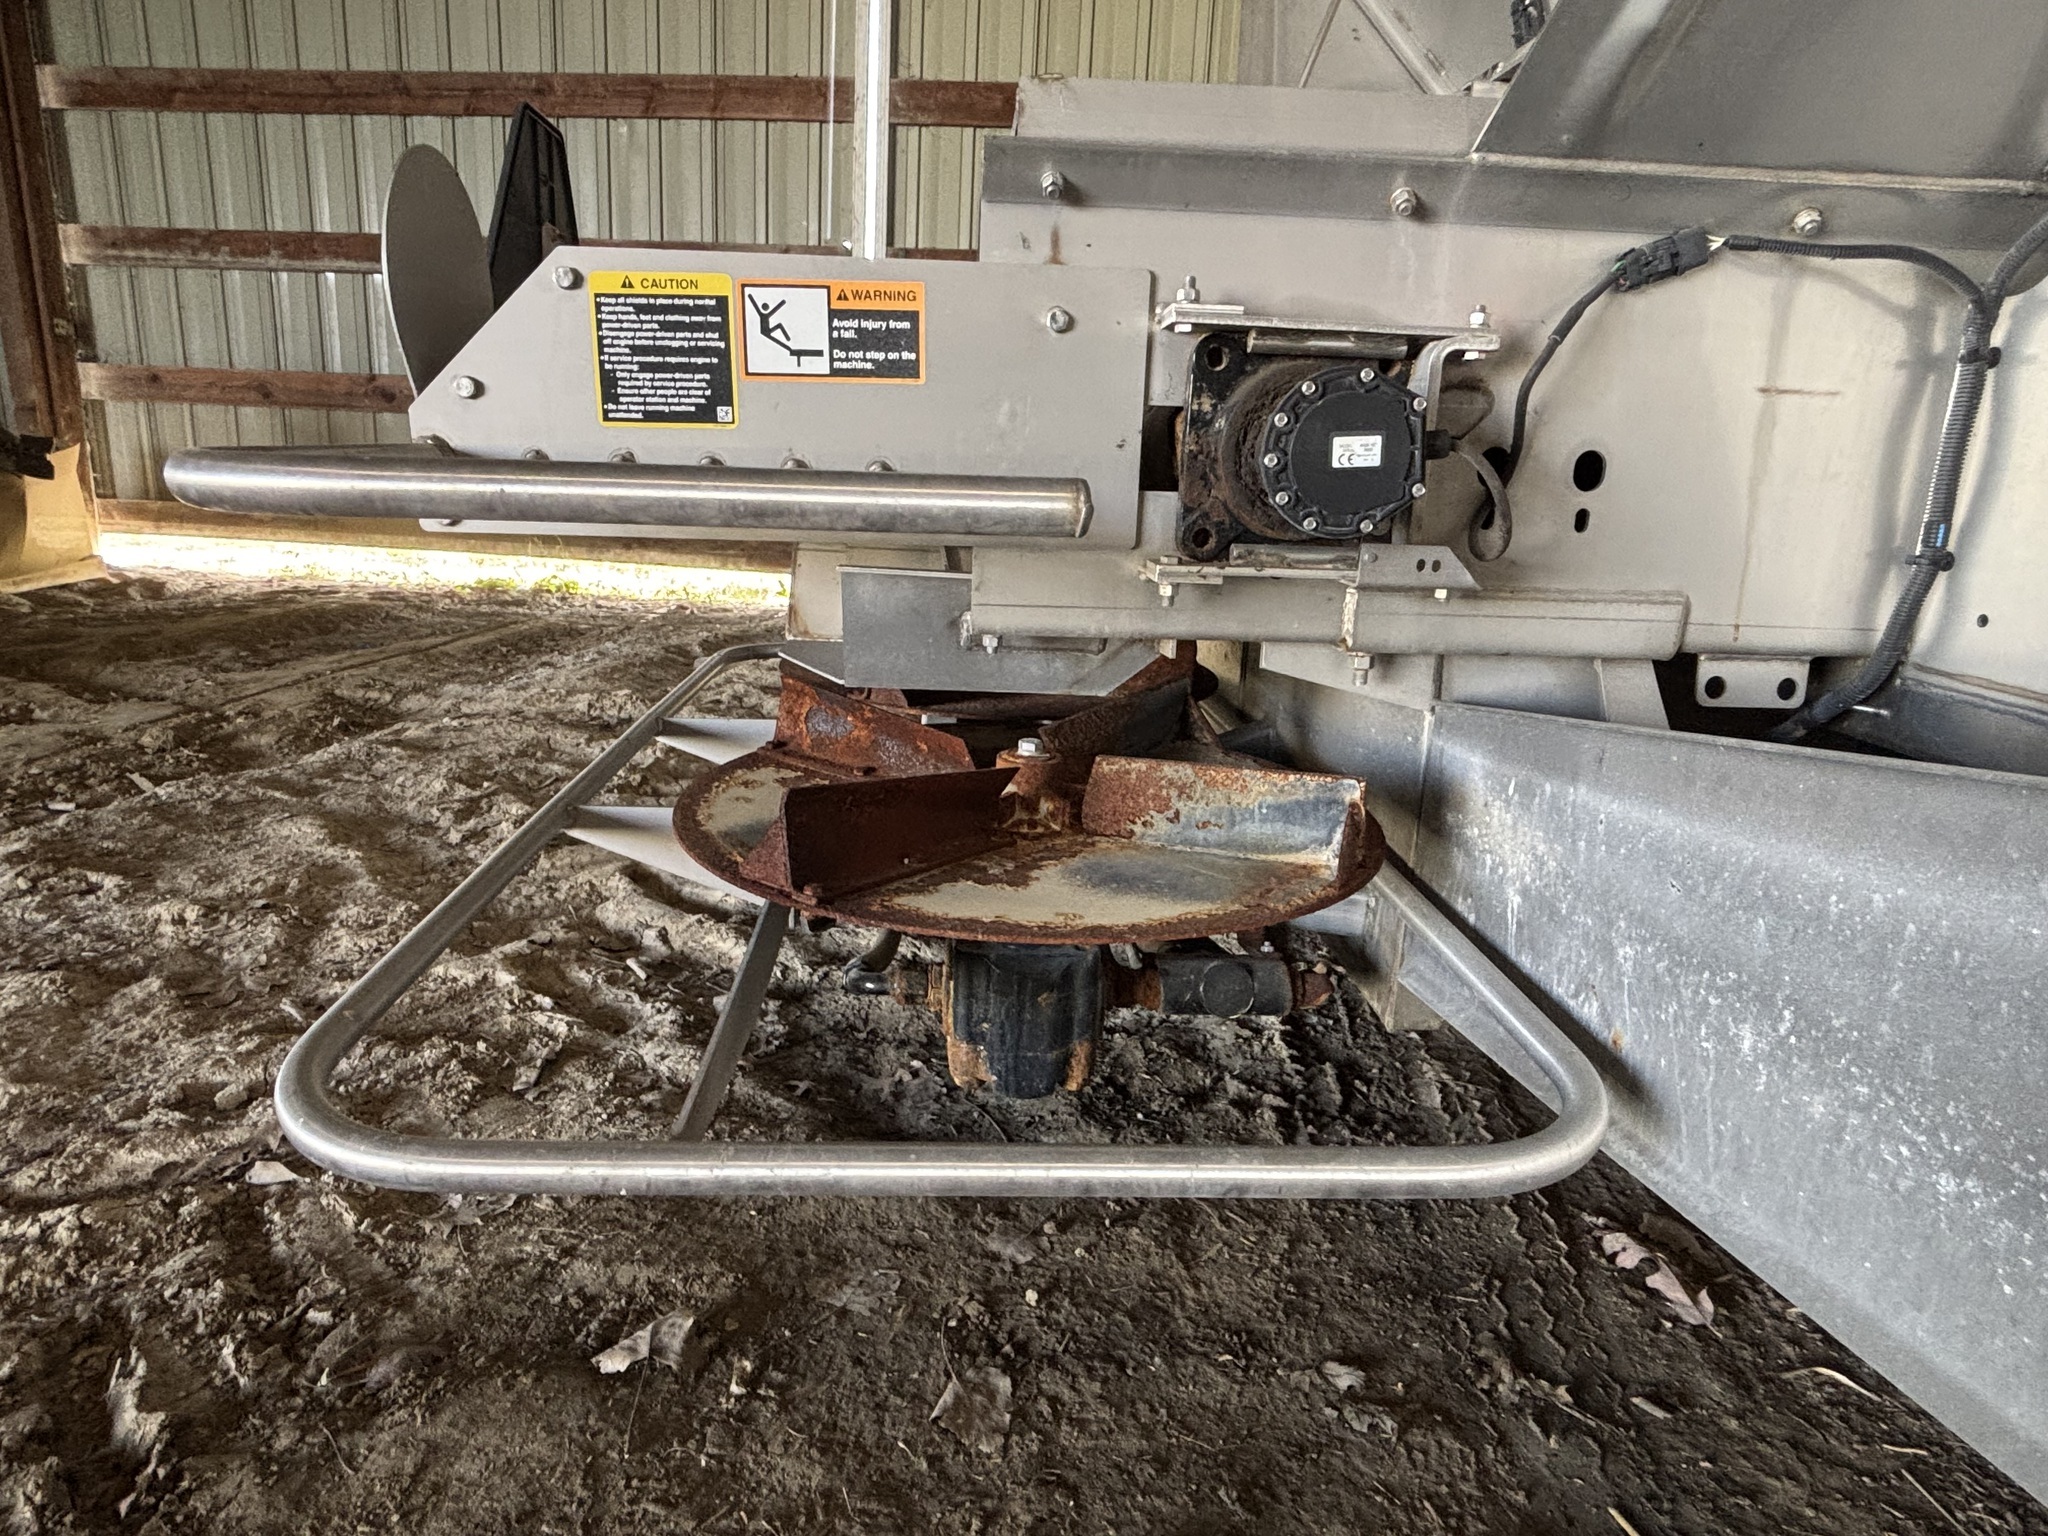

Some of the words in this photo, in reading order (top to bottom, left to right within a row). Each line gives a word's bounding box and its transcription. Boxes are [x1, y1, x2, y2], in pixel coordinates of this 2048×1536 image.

[641, 278, 698, 289] CAUTION
[851, 290, 916, 301] WARNING
[832, 319, 858, 328] Avoid
[861, 319, 887, 330] injury
[889, 320, 910, 329] from
[841, 330, 857, 338] fall.
[834, 350, 846, 358] Do
[866, 351, 885, 361] step
[902, 352, 916, 360] the
[833, 361, 874, 369] machine.
